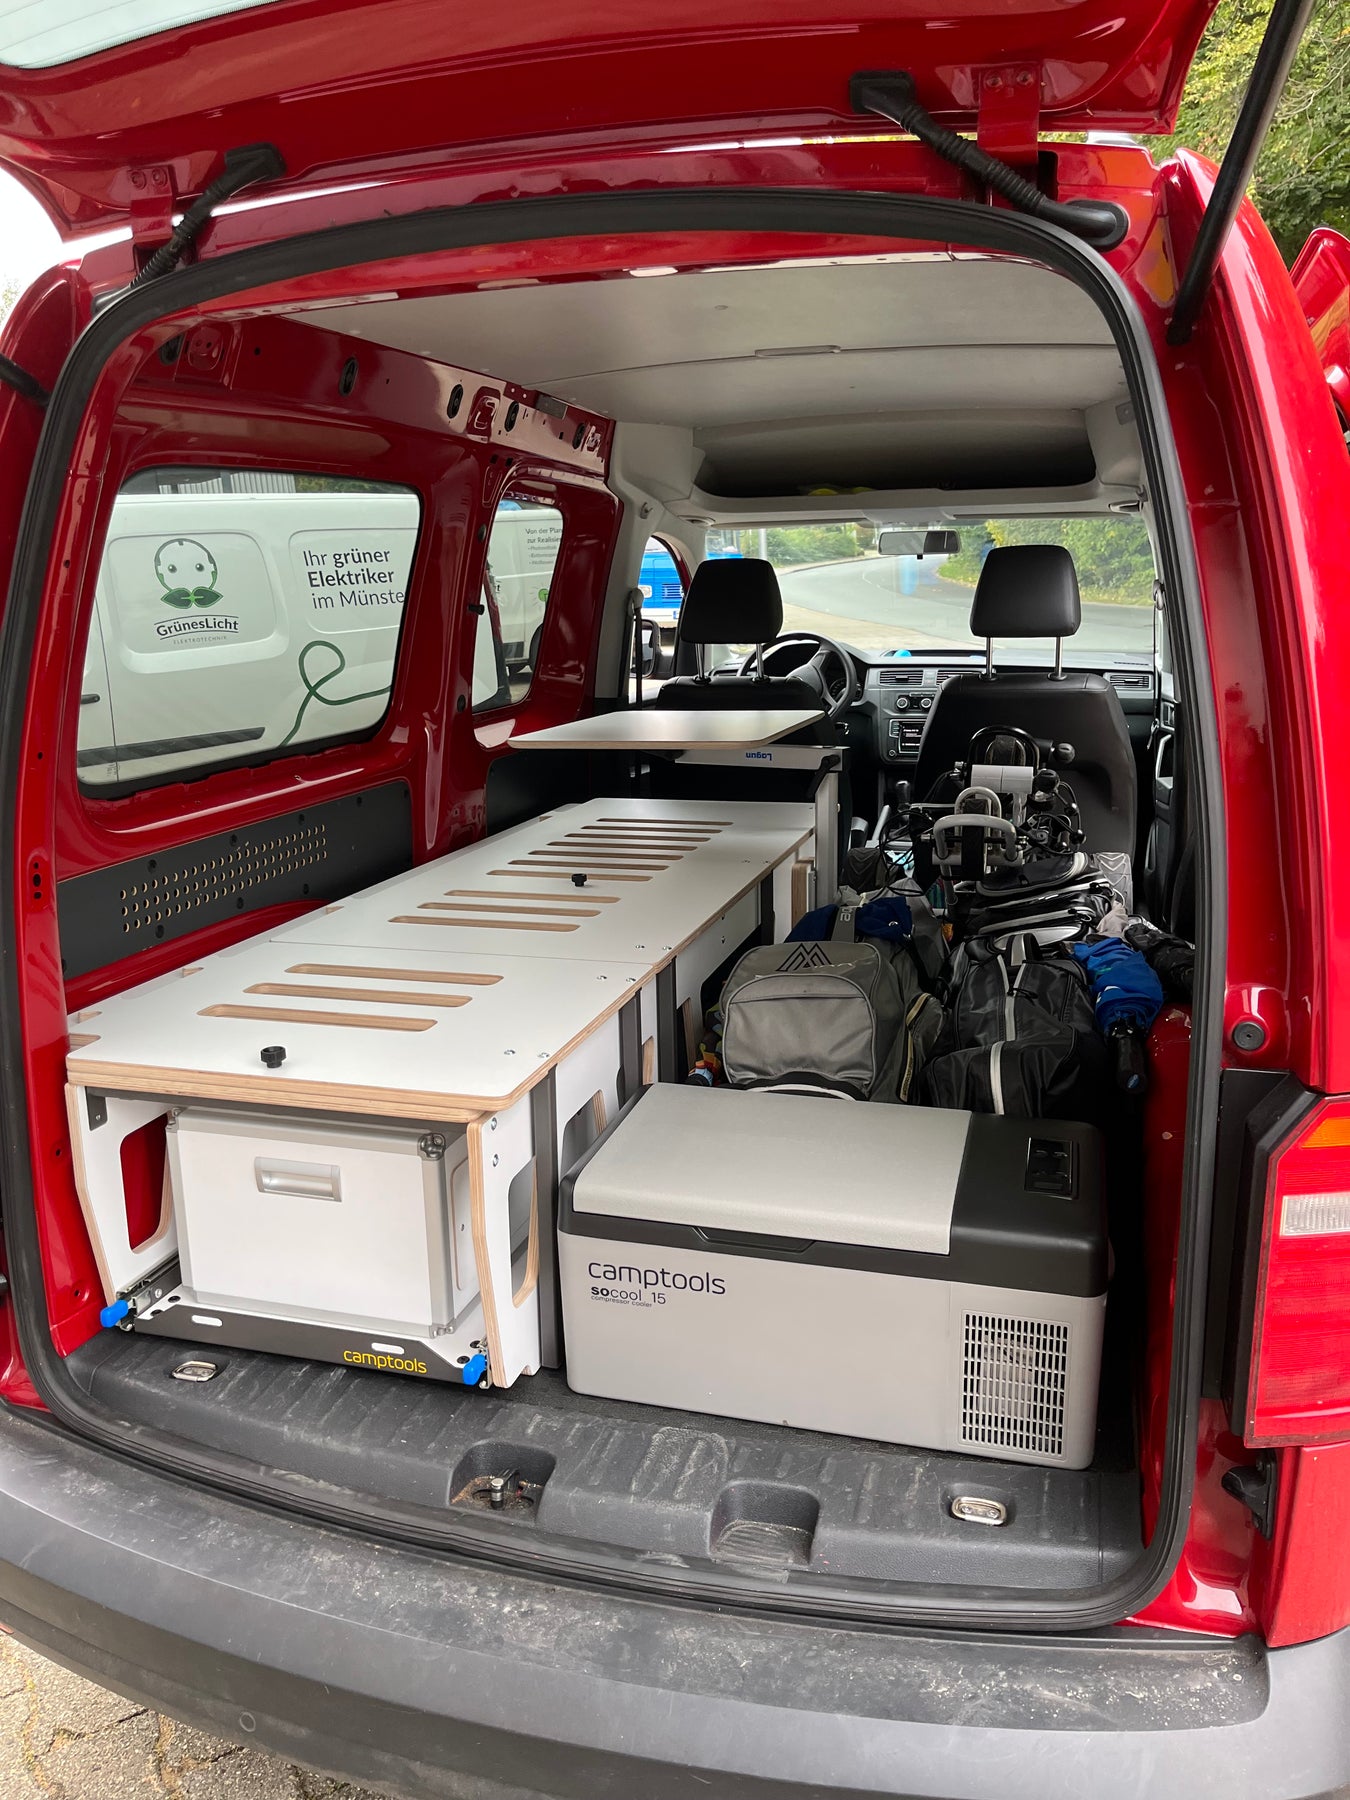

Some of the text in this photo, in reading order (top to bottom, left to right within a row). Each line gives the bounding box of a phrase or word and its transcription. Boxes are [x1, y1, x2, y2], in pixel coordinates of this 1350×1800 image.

[303, 548, 390, 568] Ihr grüner
[307, 567, 394, 588] Elektriker
[311, 593, 334, 609] im
[156, 617, 239, 636] GrünesLicht
[745, 751, 773, 761] Lagun
[588, 1262, 726, 1295] camptools
[590, 1286, 667, 1305] socool 15
[590, 1295, 631, 1305] compressor
[343, 1350, 428, 1374] camptools
